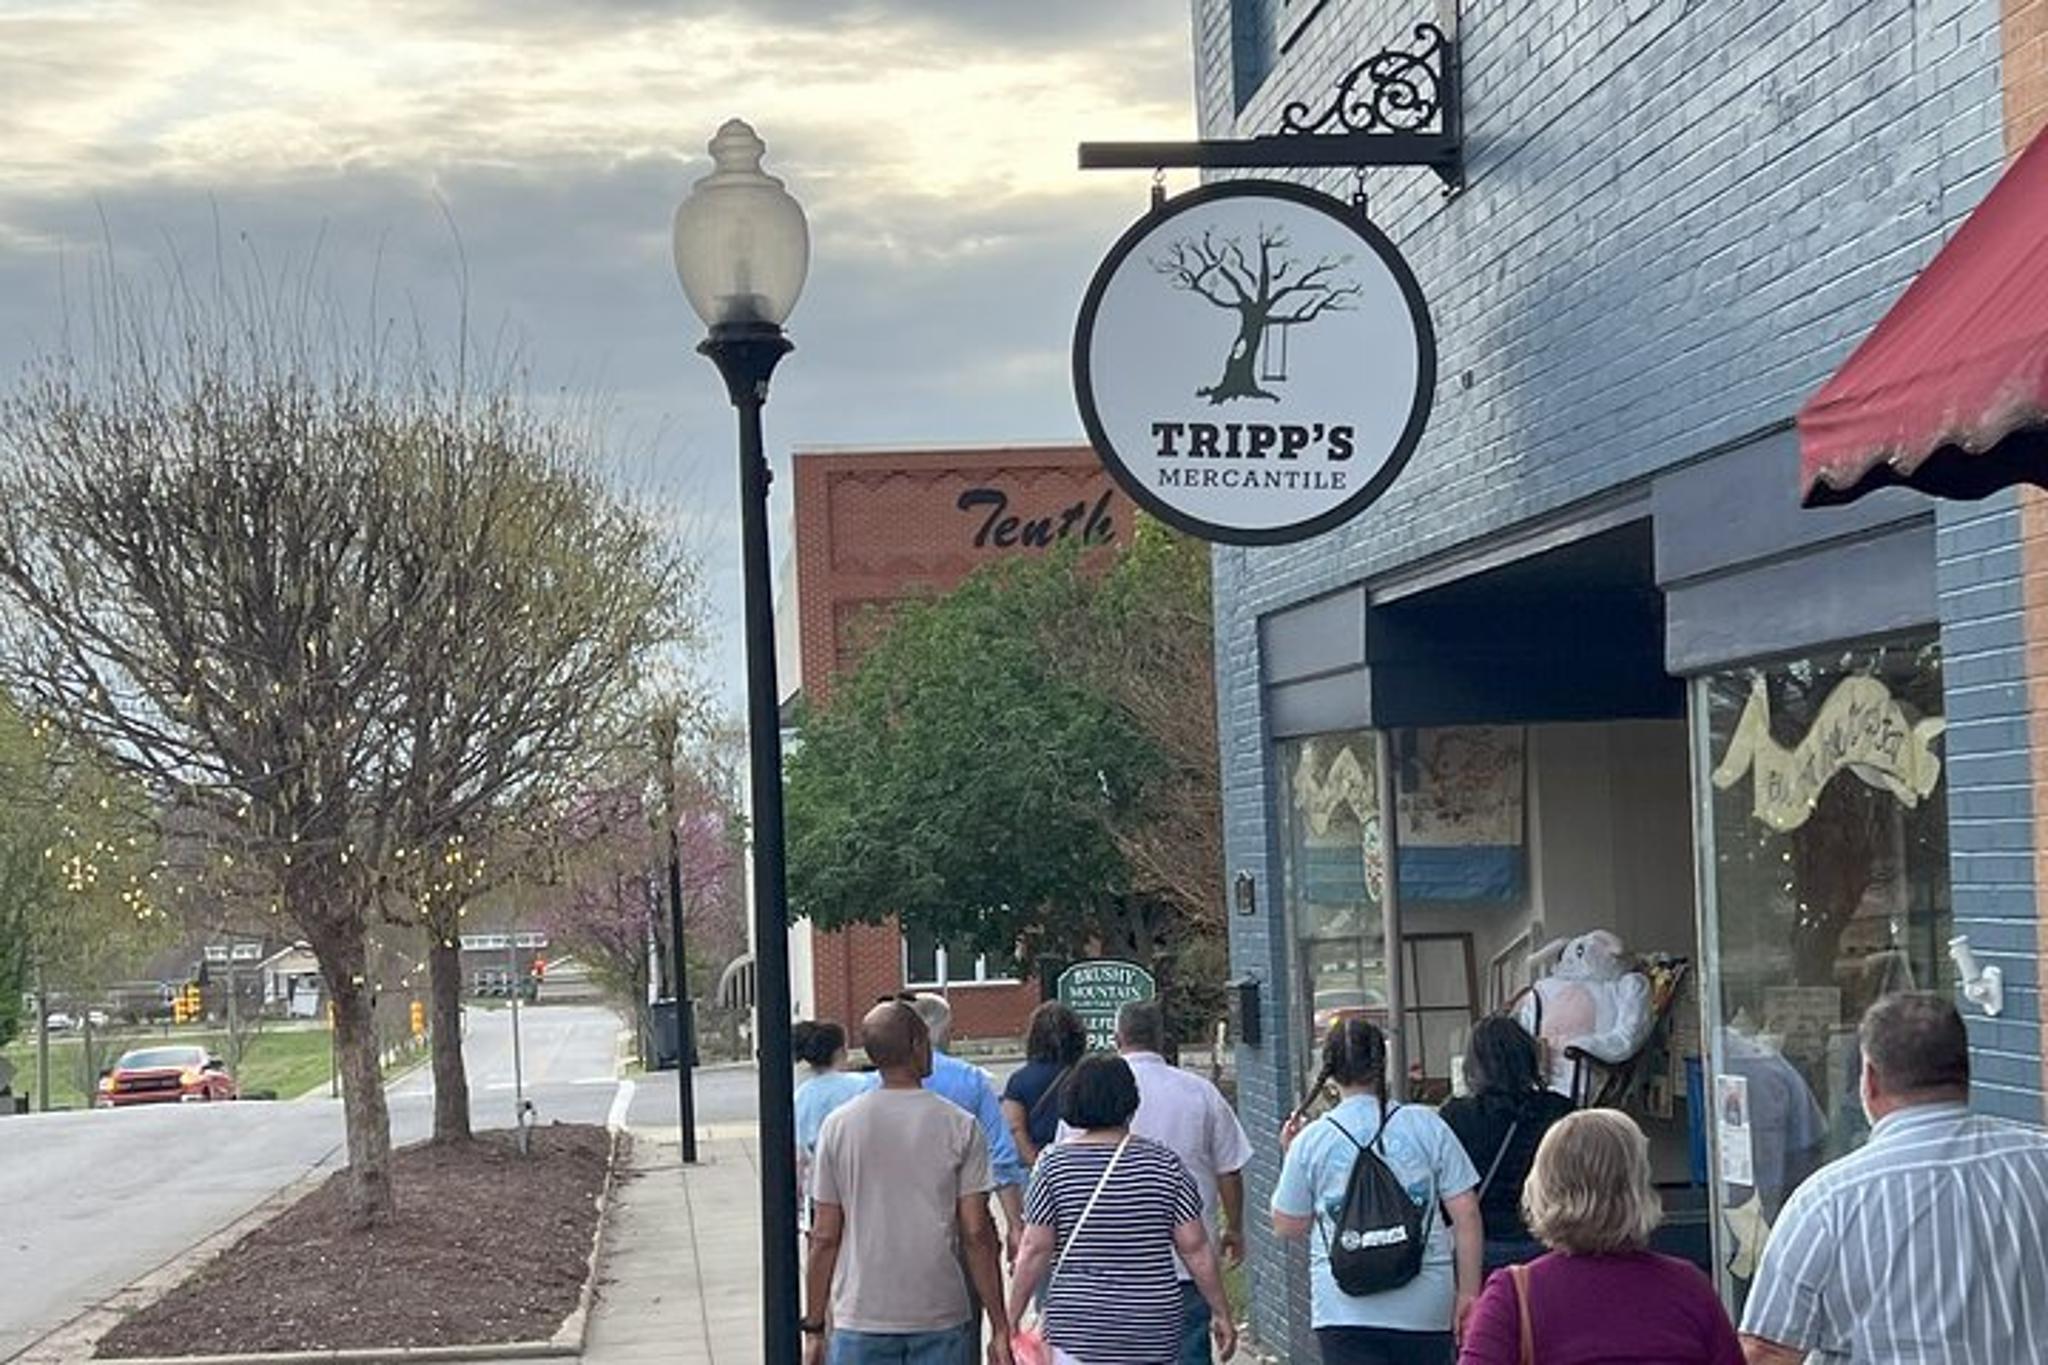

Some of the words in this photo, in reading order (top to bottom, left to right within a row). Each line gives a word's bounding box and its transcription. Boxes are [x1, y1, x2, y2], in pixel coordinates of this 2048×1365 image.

[1152, 423, 1354, 461] TRIPP'S
[1159, 469, 1347, 490] MERCANTILE
[957, 488, 1116, 547] Tenth
[1073, 966, 1137, 985] BRUSHY
[1068, 986, 1141, 999] MOUNTAIN
